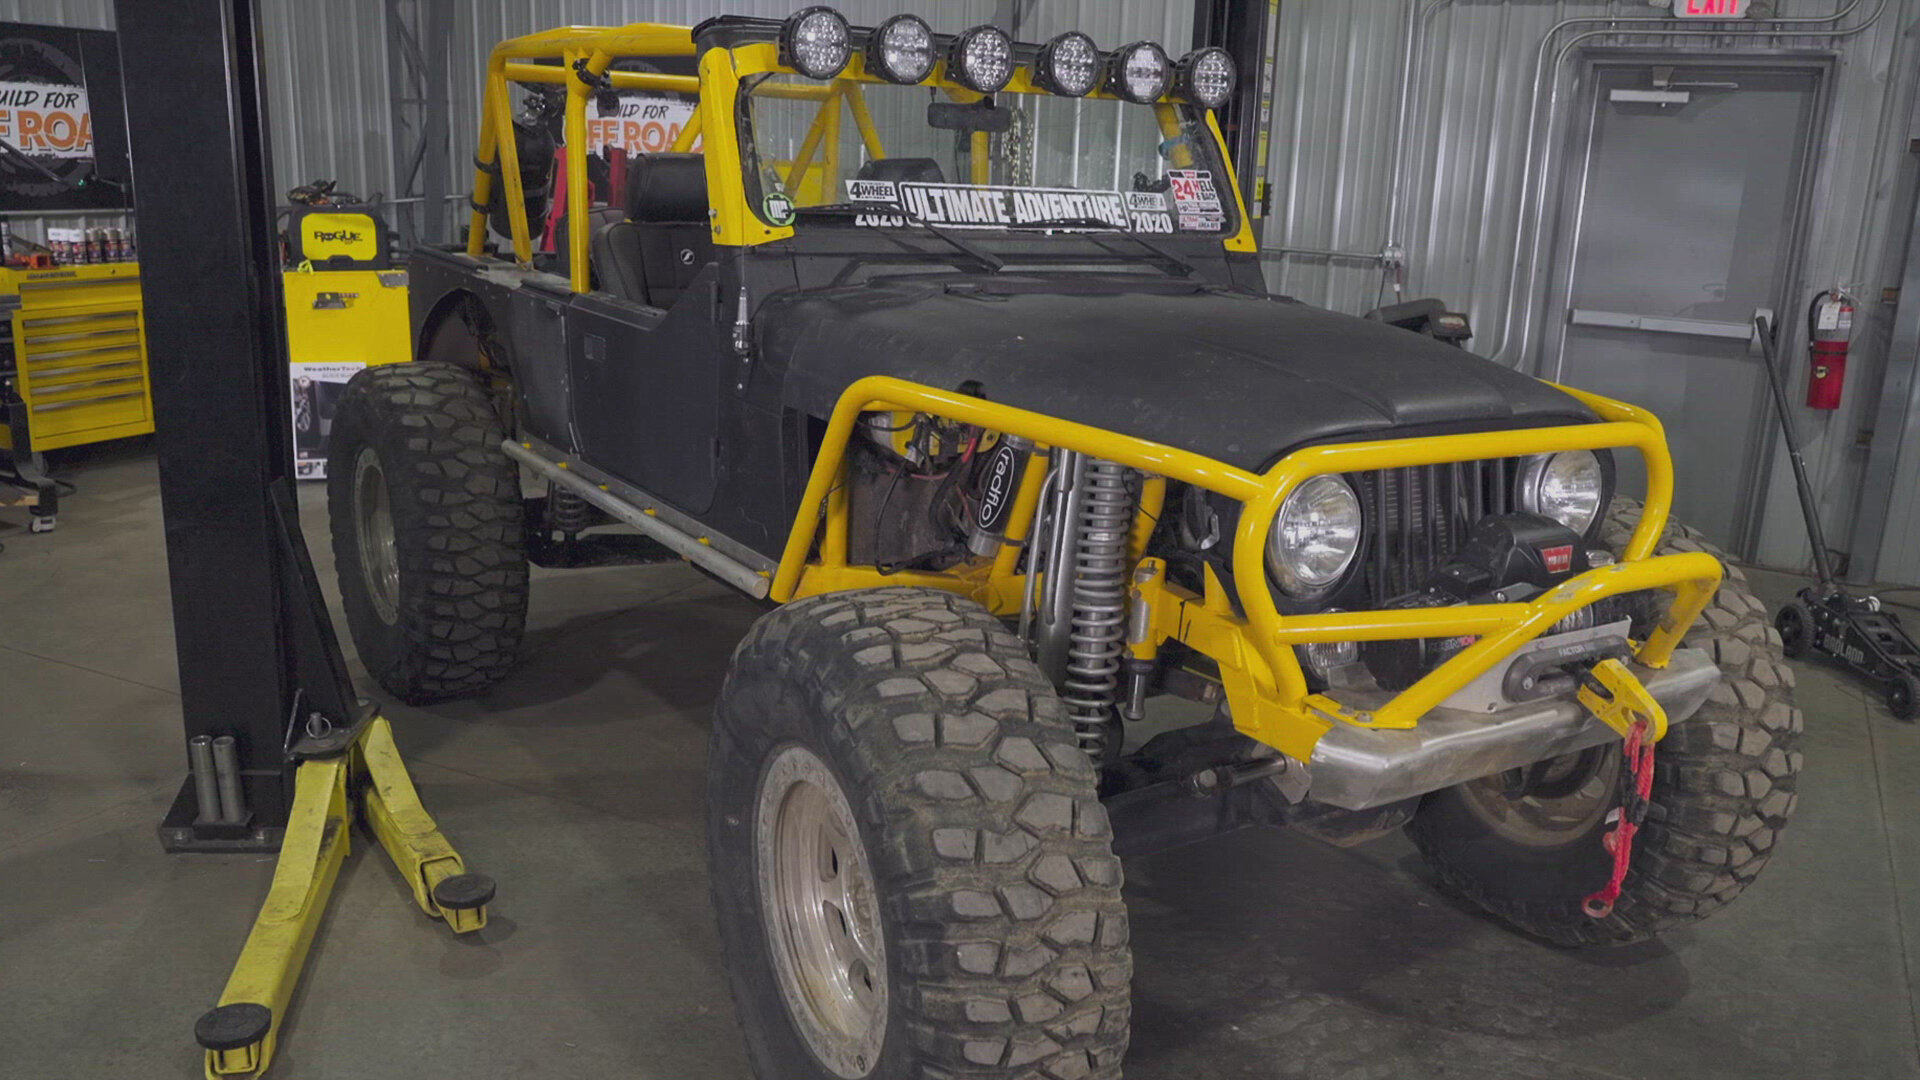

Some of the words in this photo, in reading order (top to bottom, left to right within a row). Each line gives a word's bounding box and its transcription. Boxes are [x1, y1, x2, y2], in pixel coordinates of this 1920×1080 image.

[0, 89, 39, 107] UILD
[43, 92, 79, 108] FOR
[642, 105, 669, 119] FOR
[17, 110, 92, 151] ROA
[588, 119, 619, 152] FF
[623, 121, 704, 153] ROA
[1171, 179, 1194, 200] 24
[1192, 180, 1215, 192] HELL
[904, 187, 1011, 223] ULTIMATE
[1013, 192, 1127, 226] ADVENTURE
[1131, 212, 1173, 233] 2020
[314, 229, 363, 243] ROGUE
[982, 453, 1010, 521] radflo
[1558, 644, 1586, 656] FACTOR
